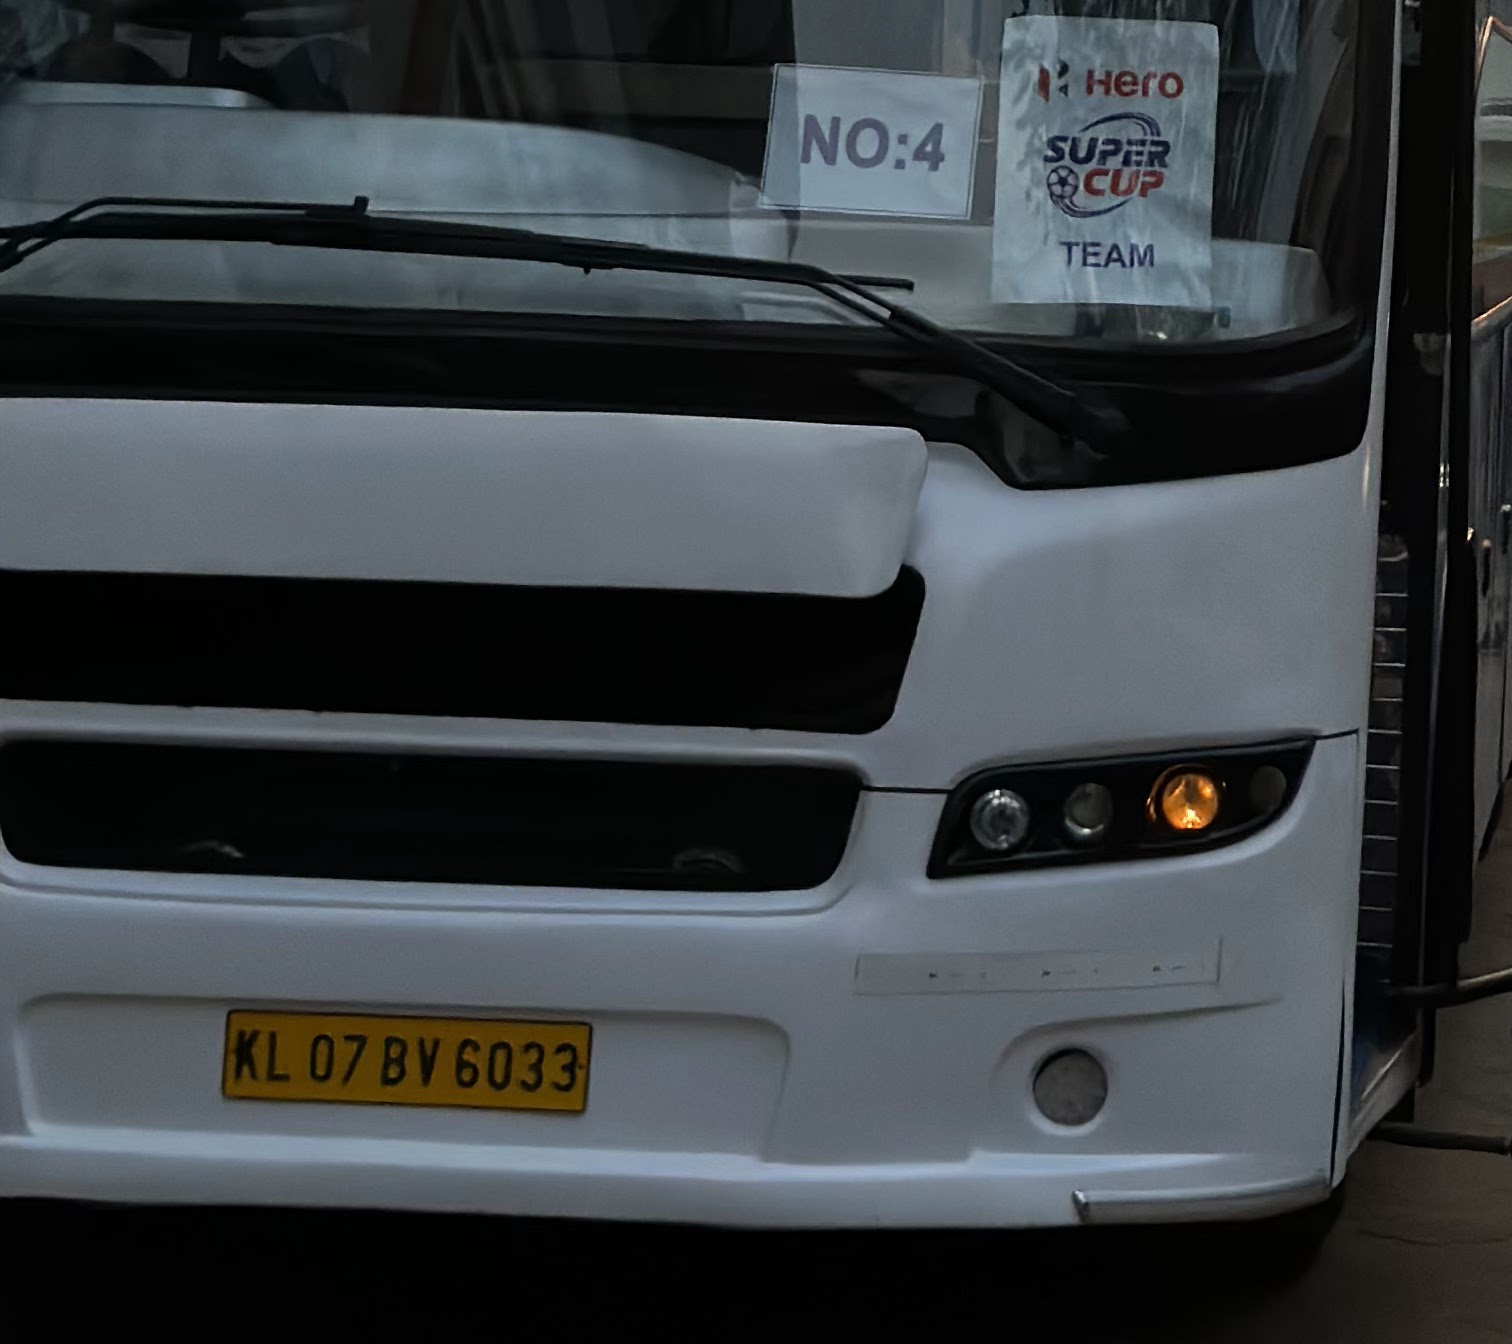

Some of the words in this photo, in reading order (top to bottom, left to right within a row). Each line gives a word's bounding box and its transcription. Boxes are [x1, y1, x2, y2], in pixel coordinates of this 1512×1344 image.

[1085, 68, 1184, 99] Hero
[799, 113, 946, 172] NO:4
[1042, 135, 1171, 168] SUPER
[1083, 168, 1165, 198] CUP
[1058, 240, 1156, 269] TEAM
[233, 1029, 290, 1083] KL
[309, 1033, 368, 1088] 07
[380, 1036, 441, 1088] BV
[454, 1038, 580, 1093] 6033
